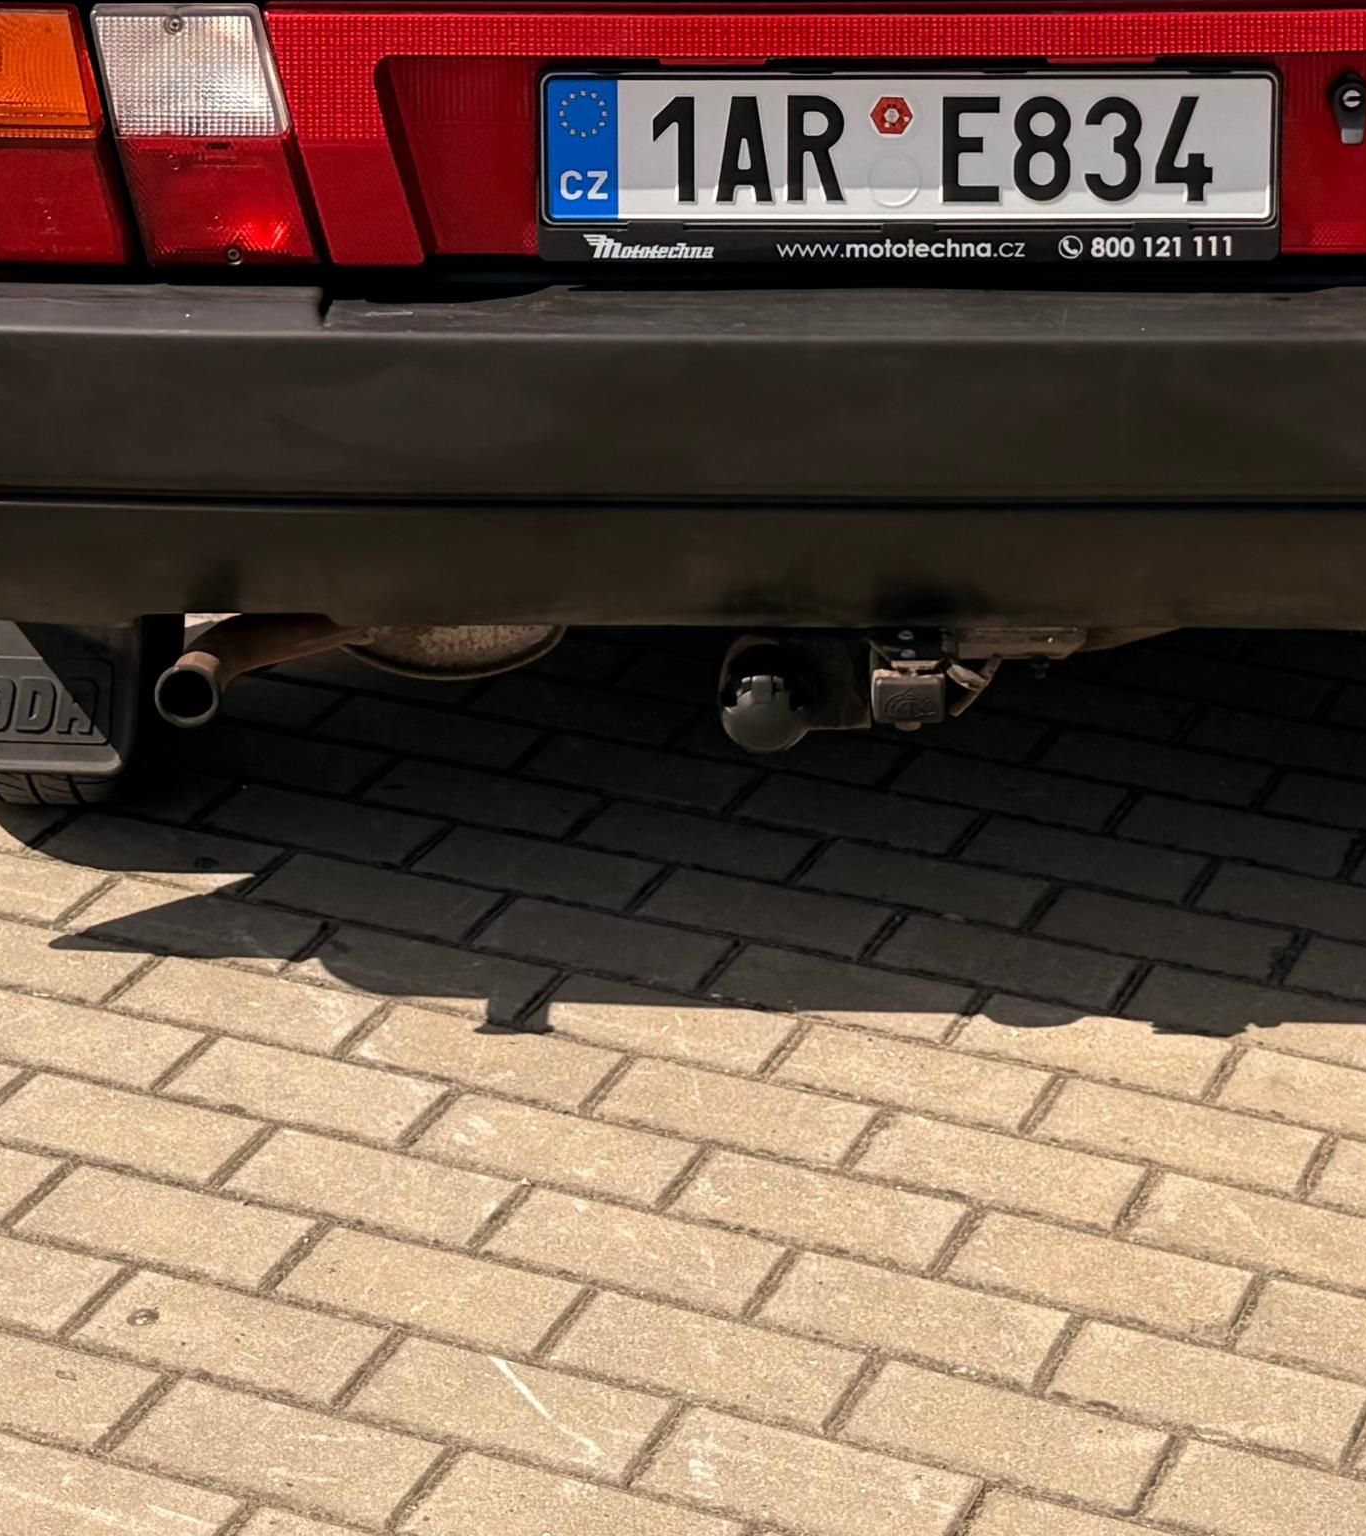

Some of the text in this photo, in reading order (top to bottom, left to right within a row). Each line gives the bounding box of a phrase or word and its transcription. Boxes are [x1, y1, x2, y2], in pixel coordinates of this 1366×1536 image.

[652, 94, 1214, 204] 1AR E834
[559, 169, 609, 202] CZ
[583, 233, 715, 261] Mototechna
[776, 237, 1026, 259] www.mototechna.cz
[1089, 234, 1233, 258] 800 121 111
